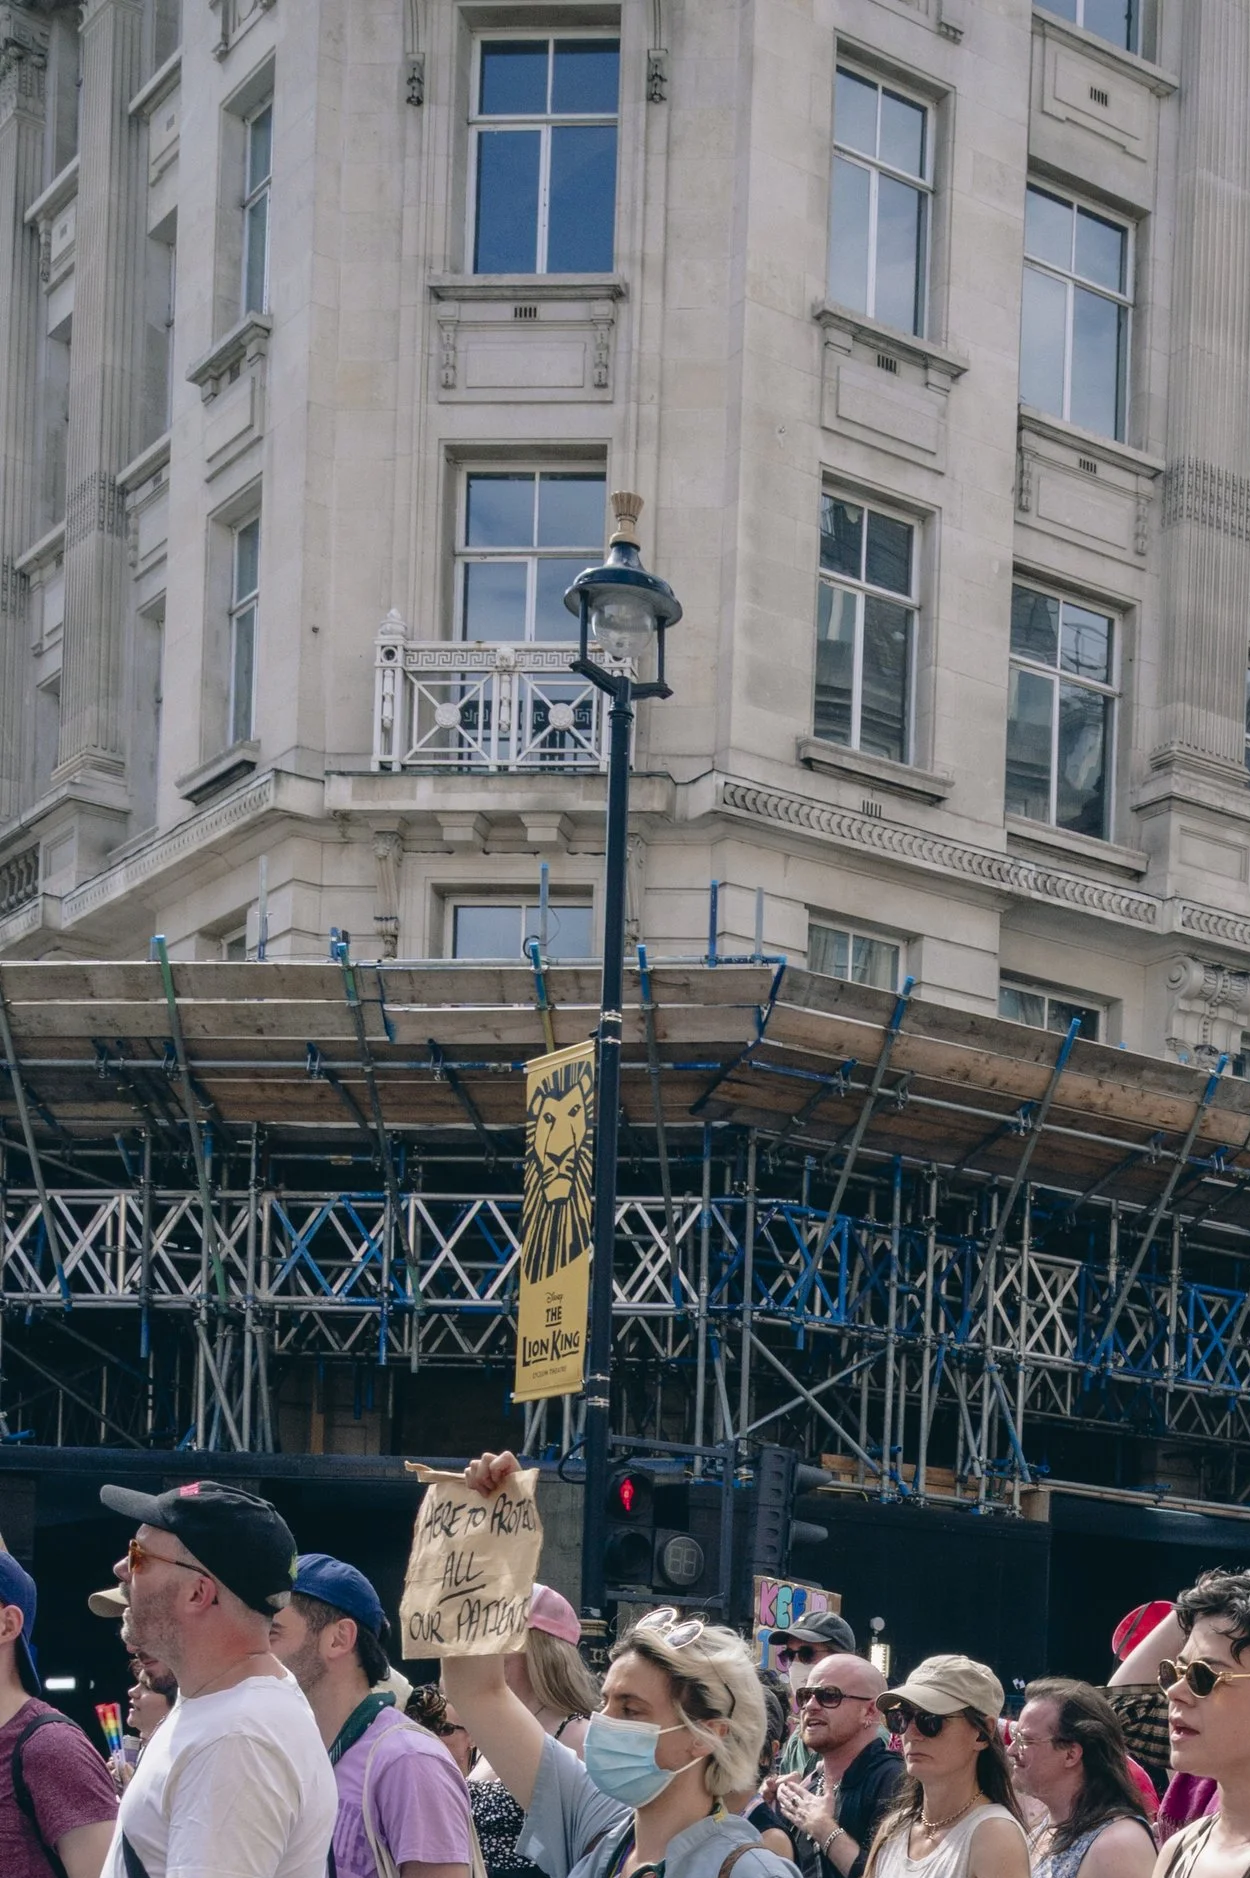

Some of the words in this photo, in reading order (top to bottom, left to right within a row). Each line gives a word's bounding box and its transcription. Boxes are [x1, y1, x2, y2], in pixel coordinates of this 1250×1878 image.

[545, 1306, 563, 1323] THE
[420, 1501, 467, 1544] HERE
[464, 1506, 487, 1535] TO
[441, 1551, 484, 1590] ALL
[409, 1611, 445, 1643] OUR
